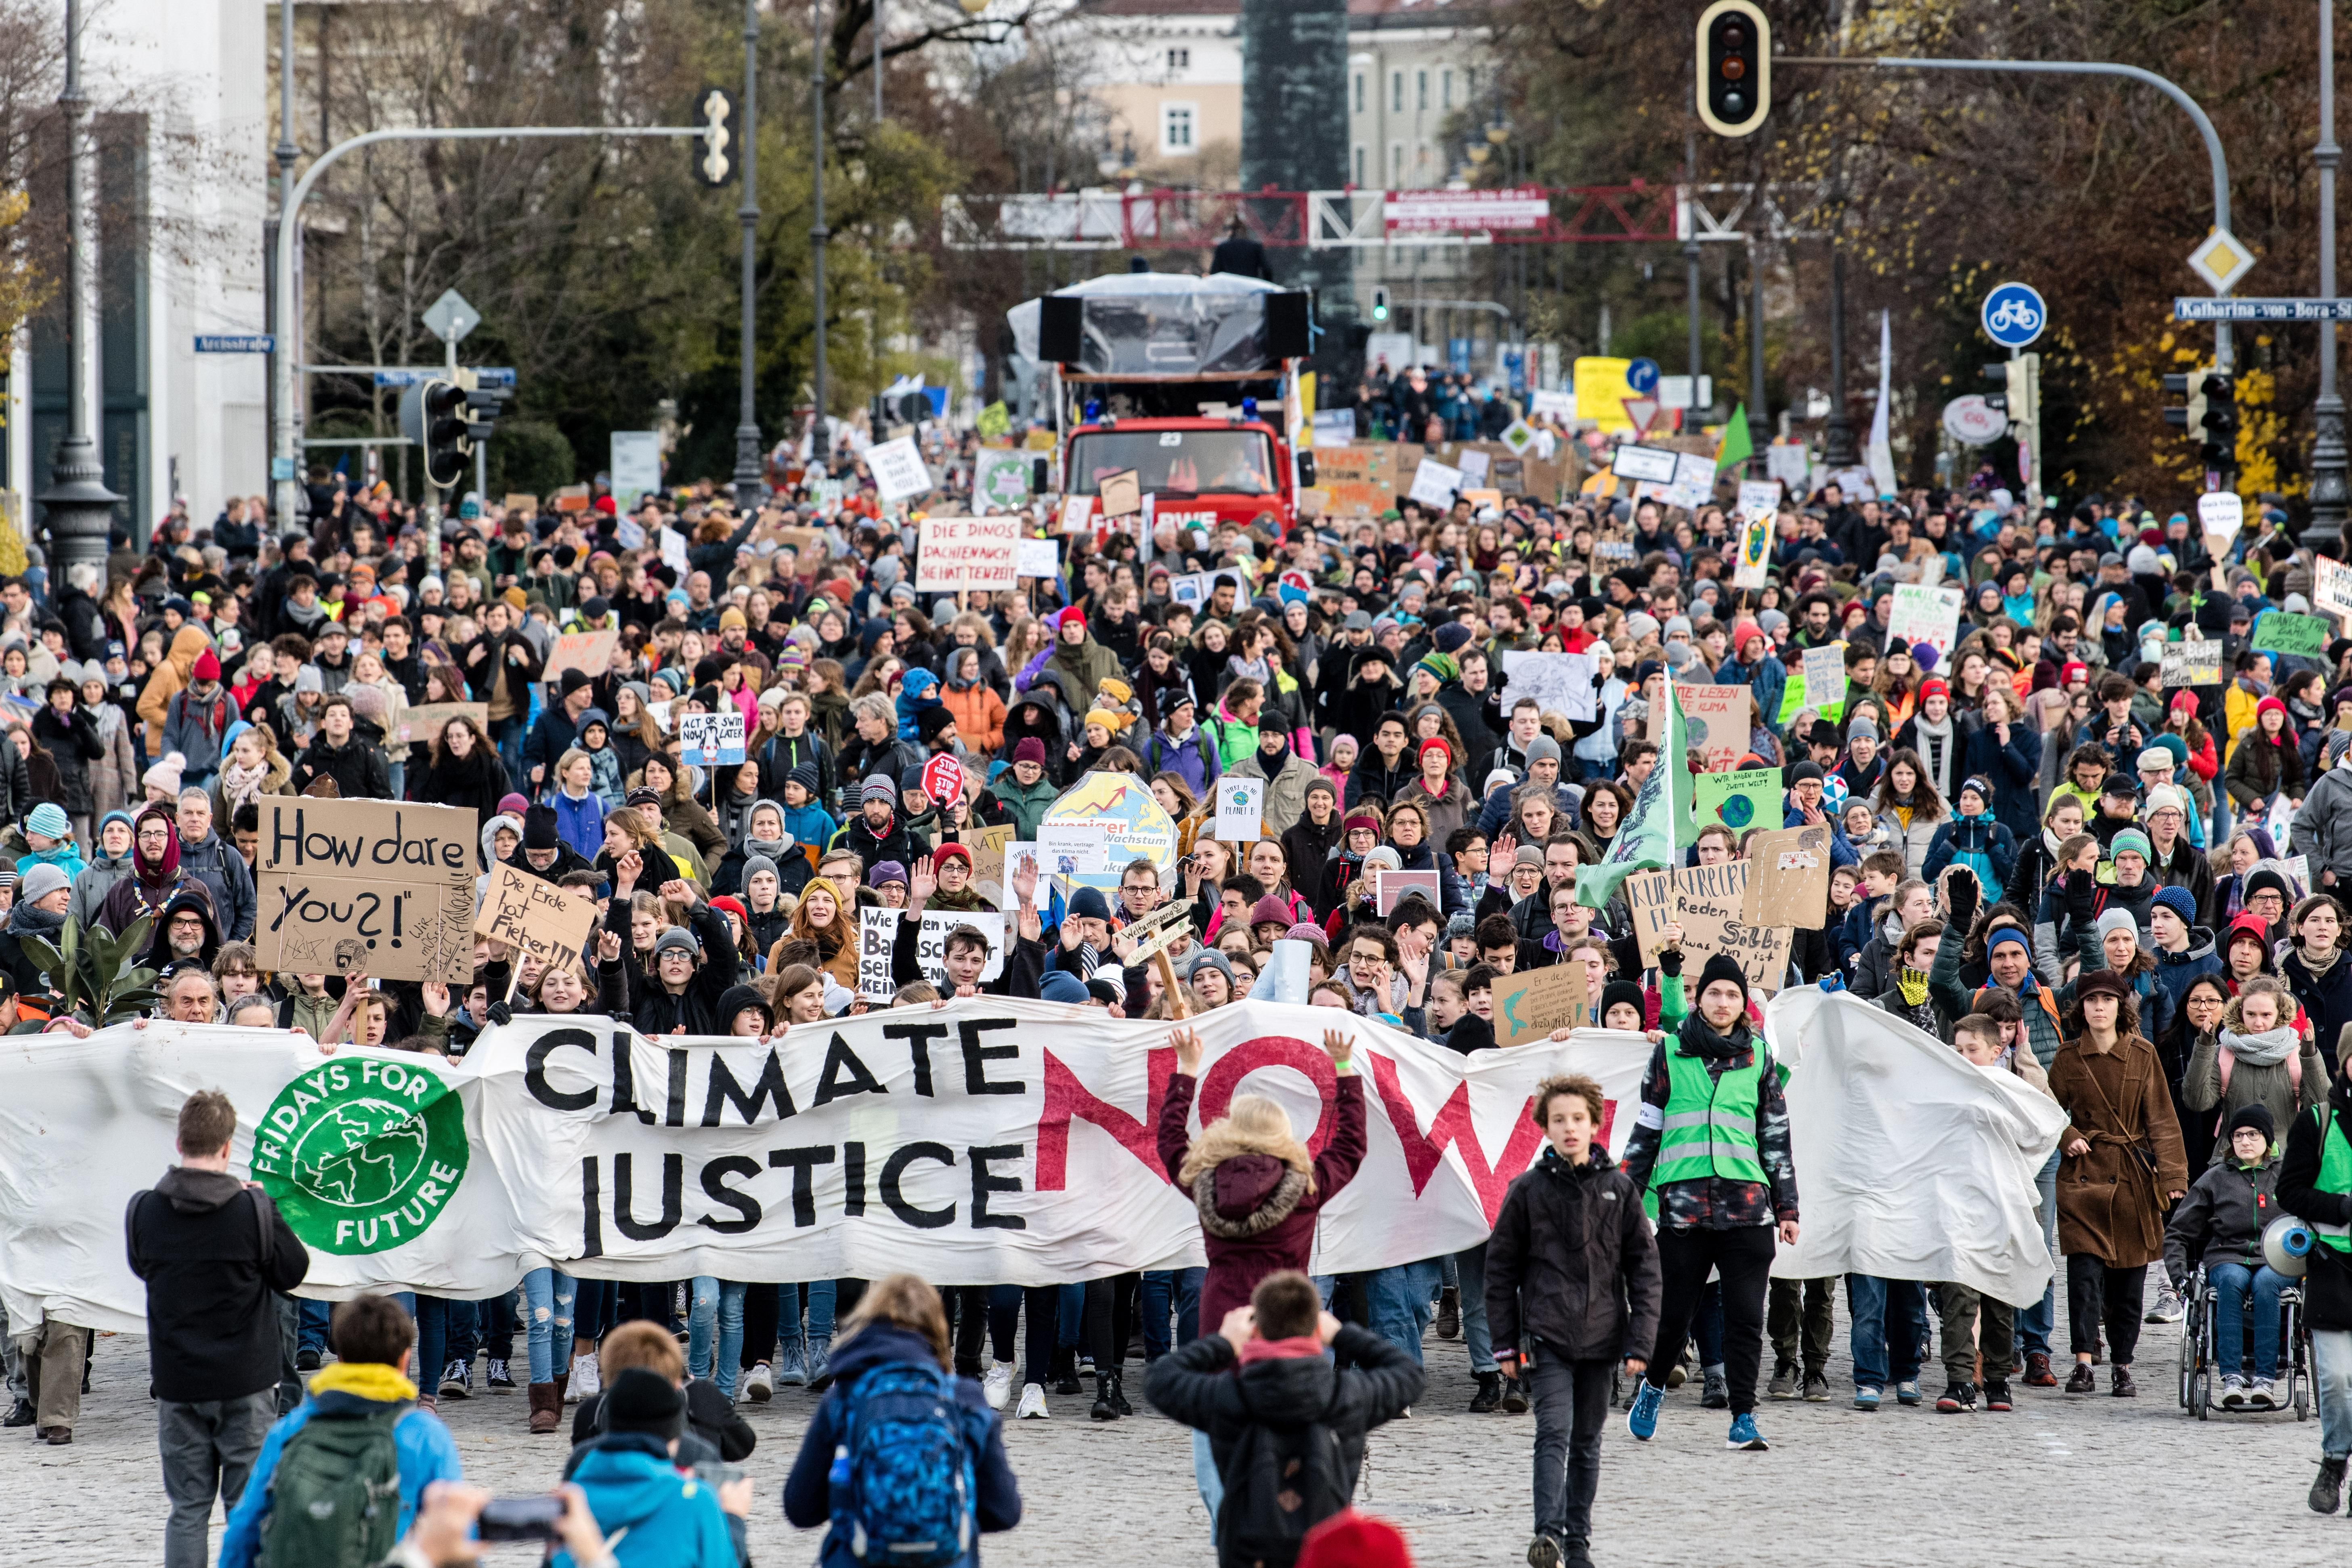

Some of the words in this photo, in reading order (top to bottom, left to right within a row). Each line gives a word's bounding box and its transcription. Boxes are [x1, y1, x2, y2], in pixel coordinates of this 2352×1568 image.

[1158, 432, 1182, 446] 23
[2162, 642, 2184, 657] Den
[1658, 686, 1695, 699] RTTE
[1699, 687, 1739, 699] LEBEN
[1658, 701, 1692, 712] RTE
[1699, 701, 1728, 712] KLIMA
[682, 719, 701, 729] ACT
[705, 716, 717, 725] OR
[721, 717, 743, 726] SWIM
[683, 730, 703, 740] NOW
[719, 728, 743, 739] LATER
[1708, 747, 1720, 758] for
[1723, 746, 1735, 757] the
[939, 758, 958, 773] STOP
[934, 766, 959, 782] Klimakrise
[1712, 774, 1730, 784] WIR
[935, 777, 955, 791] STOP
[1225, 785, 1240, 794] THERE
[1250, 787, 1258, 796] NO
[1725, 783, 1745, 791] ZWEITE
[1748, 779, 1768, 787] WELT!
[1225, 806, 1247, 815] PLANET
[1250, 807, 1255, 815] B
[371, 810, 464, 868] dare
[1104, 833, 1167, 846] Wachstum
[1012, 849, 1028, 860] THERE
[1039, 874, 1043, 882] B
[503, 869, 525, 893] Die
[531, 883, 566, 912] Erde
[497, 890, 530, 919] hat
[1677, 896, 1728, 919] Reden
[864, 909, 892, 928] Wie
[1121, 910, 1174, 940] Weltuntergang
[490, 914, 577, 972] Fieber!!!
[1131, 947, 1148, 963] Welt
[1152, 931, 1178, 950] Retten
[1680, 931, 1711, 951] twas
[1720, 945, 1740, 957] tun
[1754, 951, 1774, 962] ist
[1534, 976, 1542, 987] Er
[1551, 972, 1563, 981] de,
[1531, 1014, 1572, 1033] einzigartig
[256, 1065, 350, 1174] FRIDAYS
[363, 1061, 428, 1104] FOR
[525, 1018, 1026, 1127] CLIMATE
[1036, 1036, 1618, 1231] NOW
[335, 1159, 459, 1247] FUTURE
[566, 1142, 1026, 1260] JUSTICE
